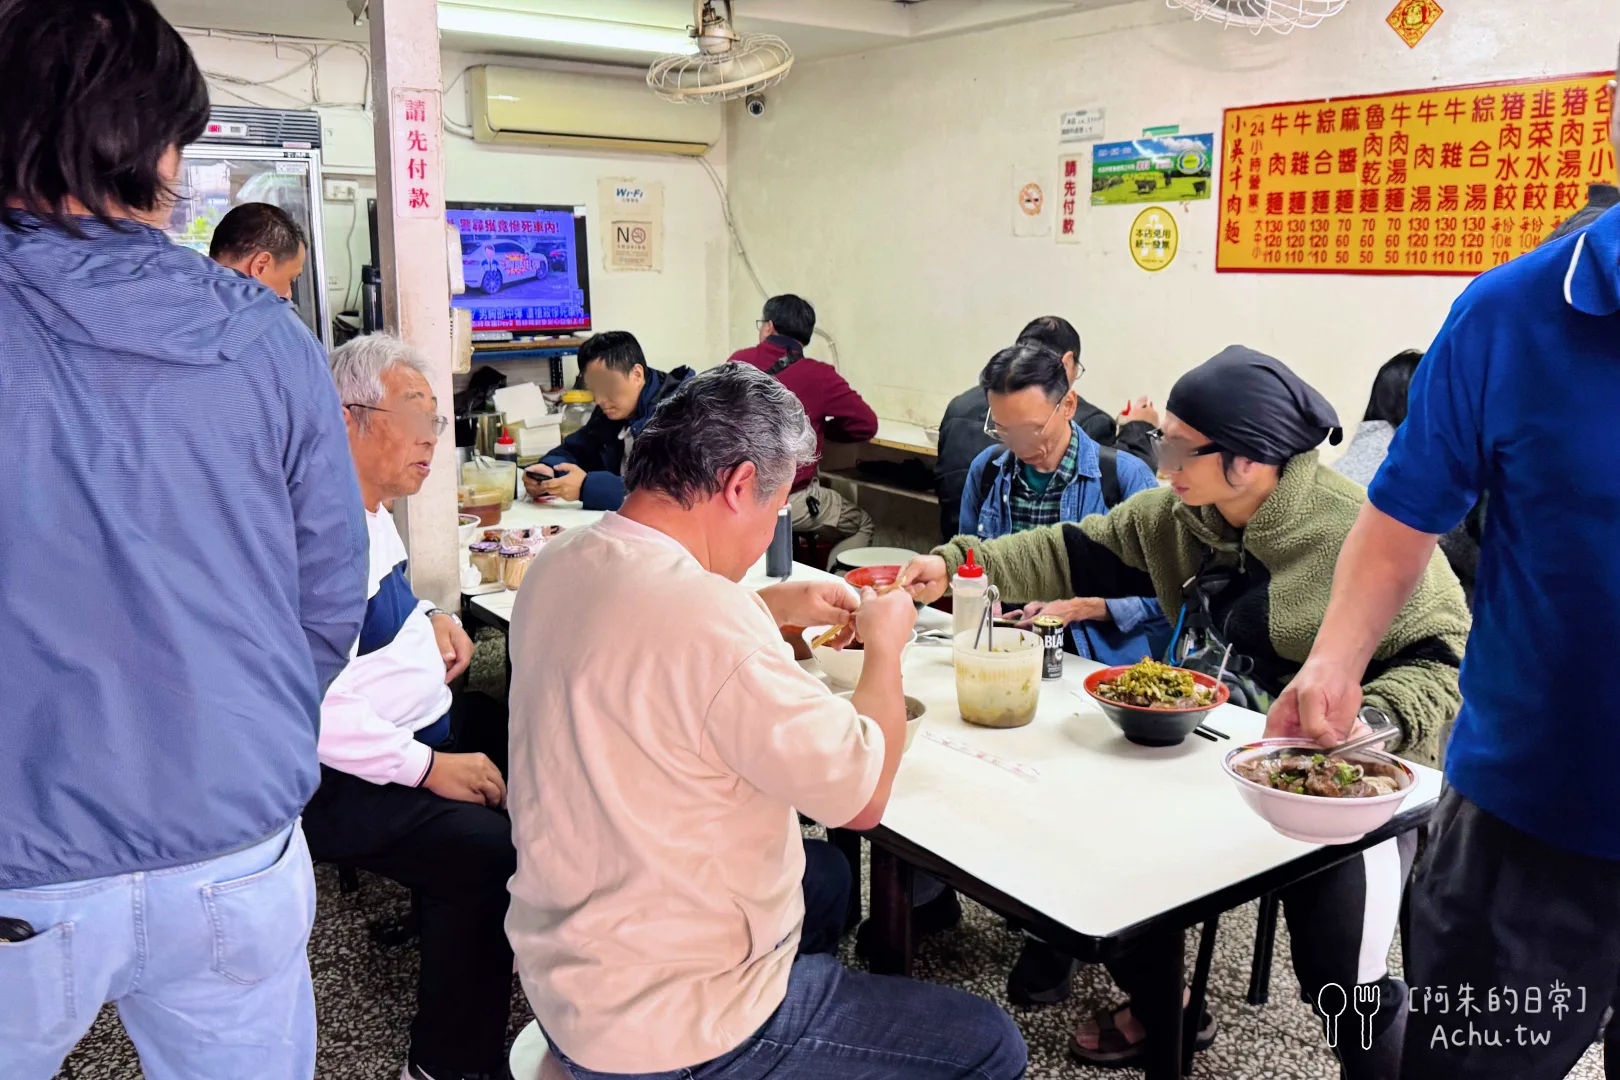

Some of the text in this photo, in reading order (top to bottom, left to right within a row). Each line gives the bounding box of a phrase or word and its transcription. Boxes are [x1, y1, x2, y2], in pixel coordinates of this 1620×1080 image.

[404, 100, 430, 208] 請先付款
[616, 188, 644, 198] Wi-Fi
[1062, 160, 1077, 234] 請先付款
[1266, 112, 1288, 215] 牛肉麵
[1311, 108, 1335, 214] 綜合麵
[1359, 104, 1385, 213] 魯肉乾麵
[1384, 101, 1411, 213] 牛肉湯麵
[1410, 99, 1438, 212] 牛肉湯
[1464, 94, 1495, 212] 綜合湯
[1523, 89, 1555, 210] 韭菜水餃
[1263, 250, 1281, 263] 110
[1285, 250, 1304, 263] 110
[1308, 250, 1328, 263] 110
[1335, 251, 1349, 263] 50
[1359, 250, 1374, 264] 50
[1385, 250, 1399, 264] 50
[1405, 250, 1427, 264] 110
[1432, 250, 1455, 264] 110
[1459, 250, 1483, 264] 110
[1264, 233, 1485, 248] 120 120 120 60 60 60 120 120 120
[1265, 216, 1486, 233] 130 130 130 70 70 70 130 130 130
